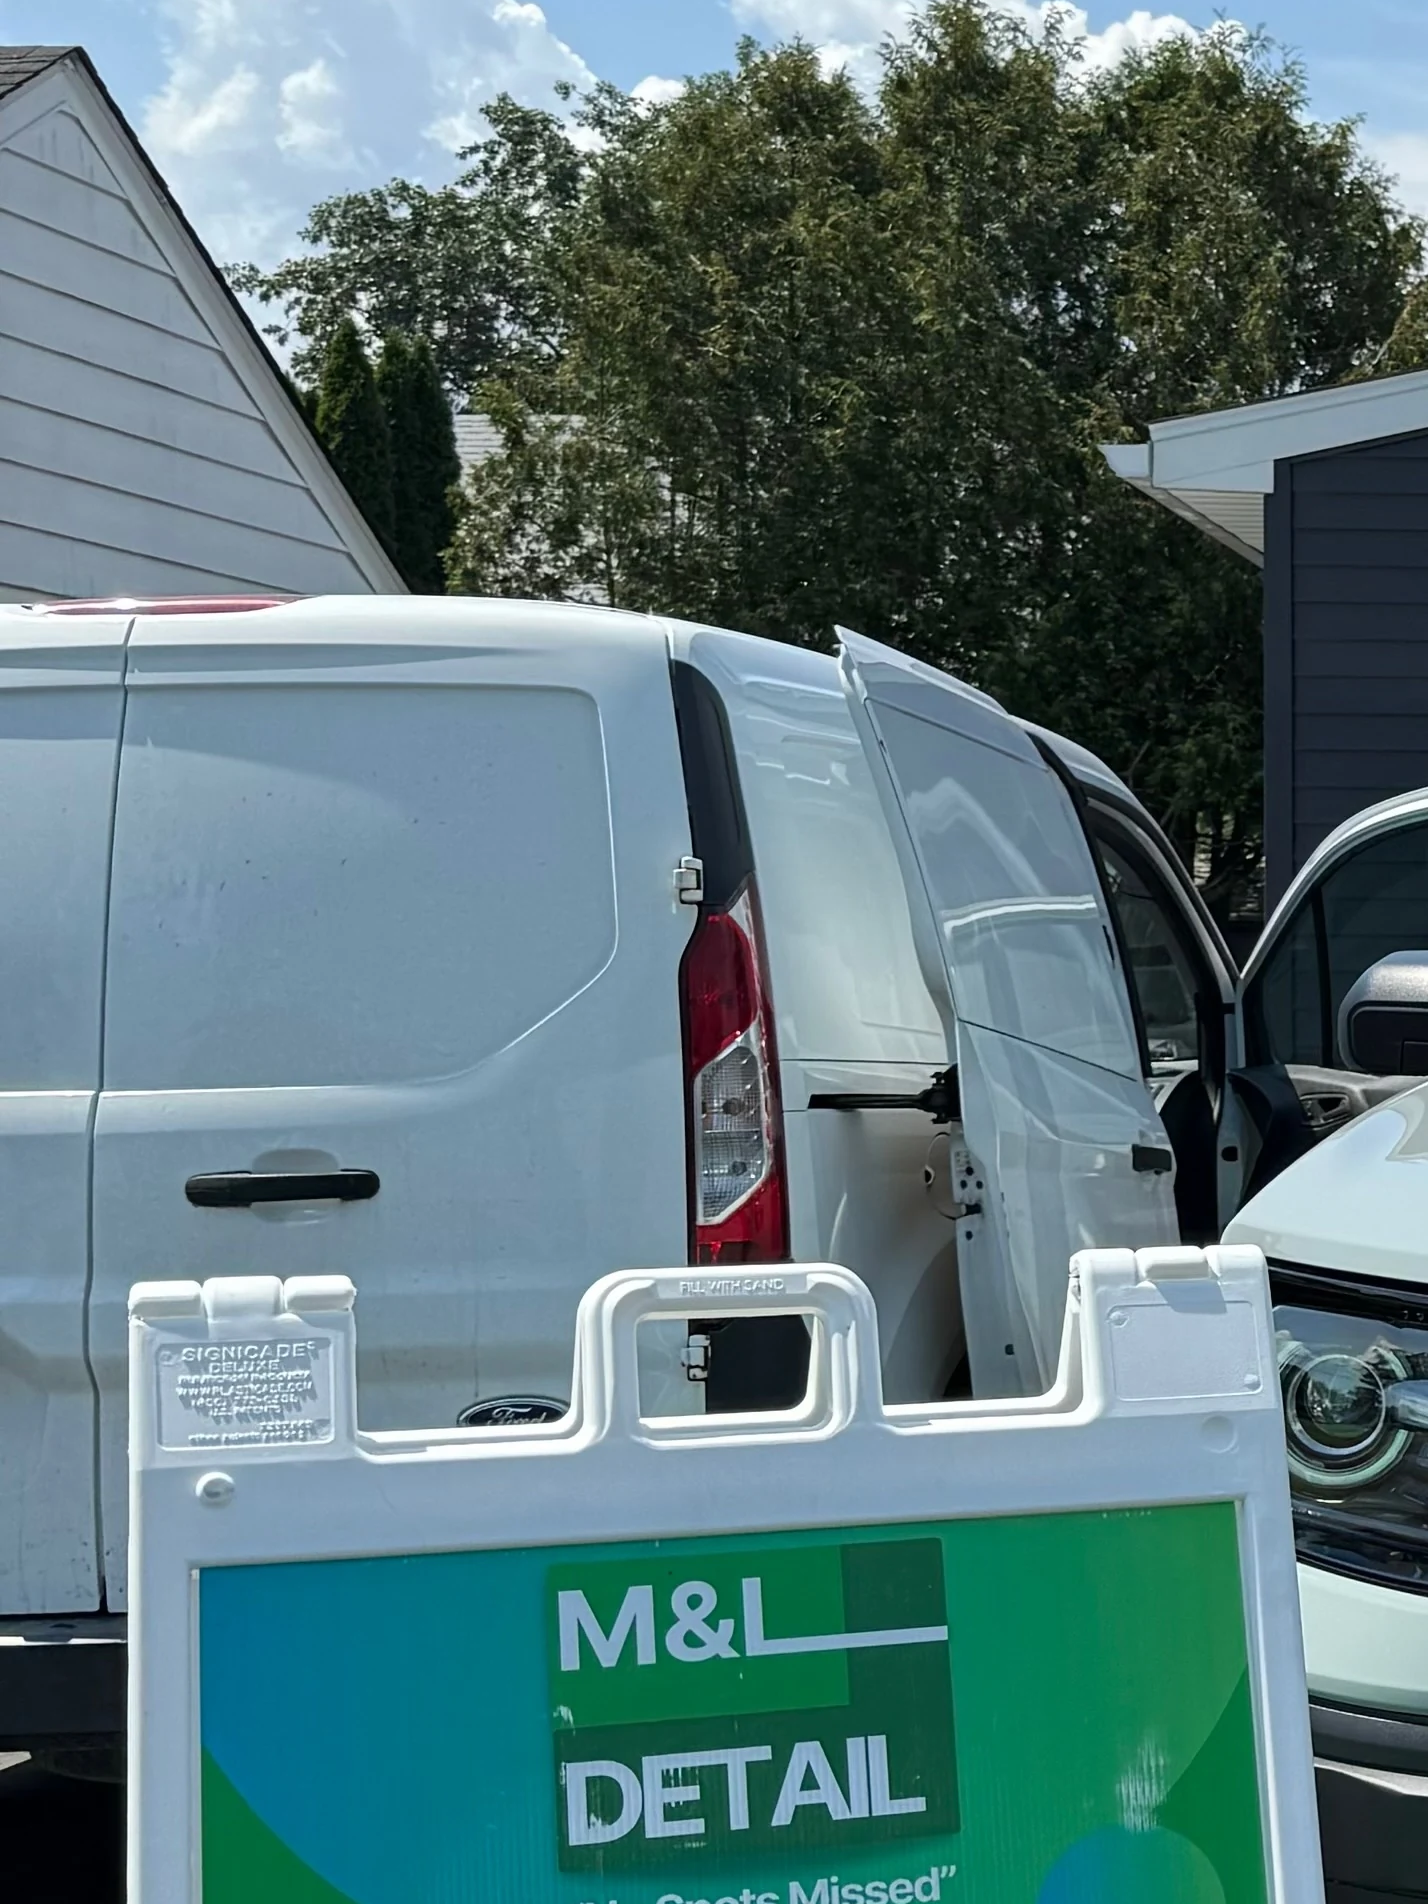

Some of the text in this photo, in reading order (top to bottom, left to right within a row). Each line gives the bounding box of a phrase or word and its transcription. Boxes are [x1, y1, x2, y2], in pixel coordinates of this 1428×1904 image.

[679, 1277, 784, 1293] FILL WITH SAND
[208, 1359, 281, 1374] DELUXE
[558, 1578, 948, 1672] M&L
[565, 1734, 927, 1847] DETAIL
